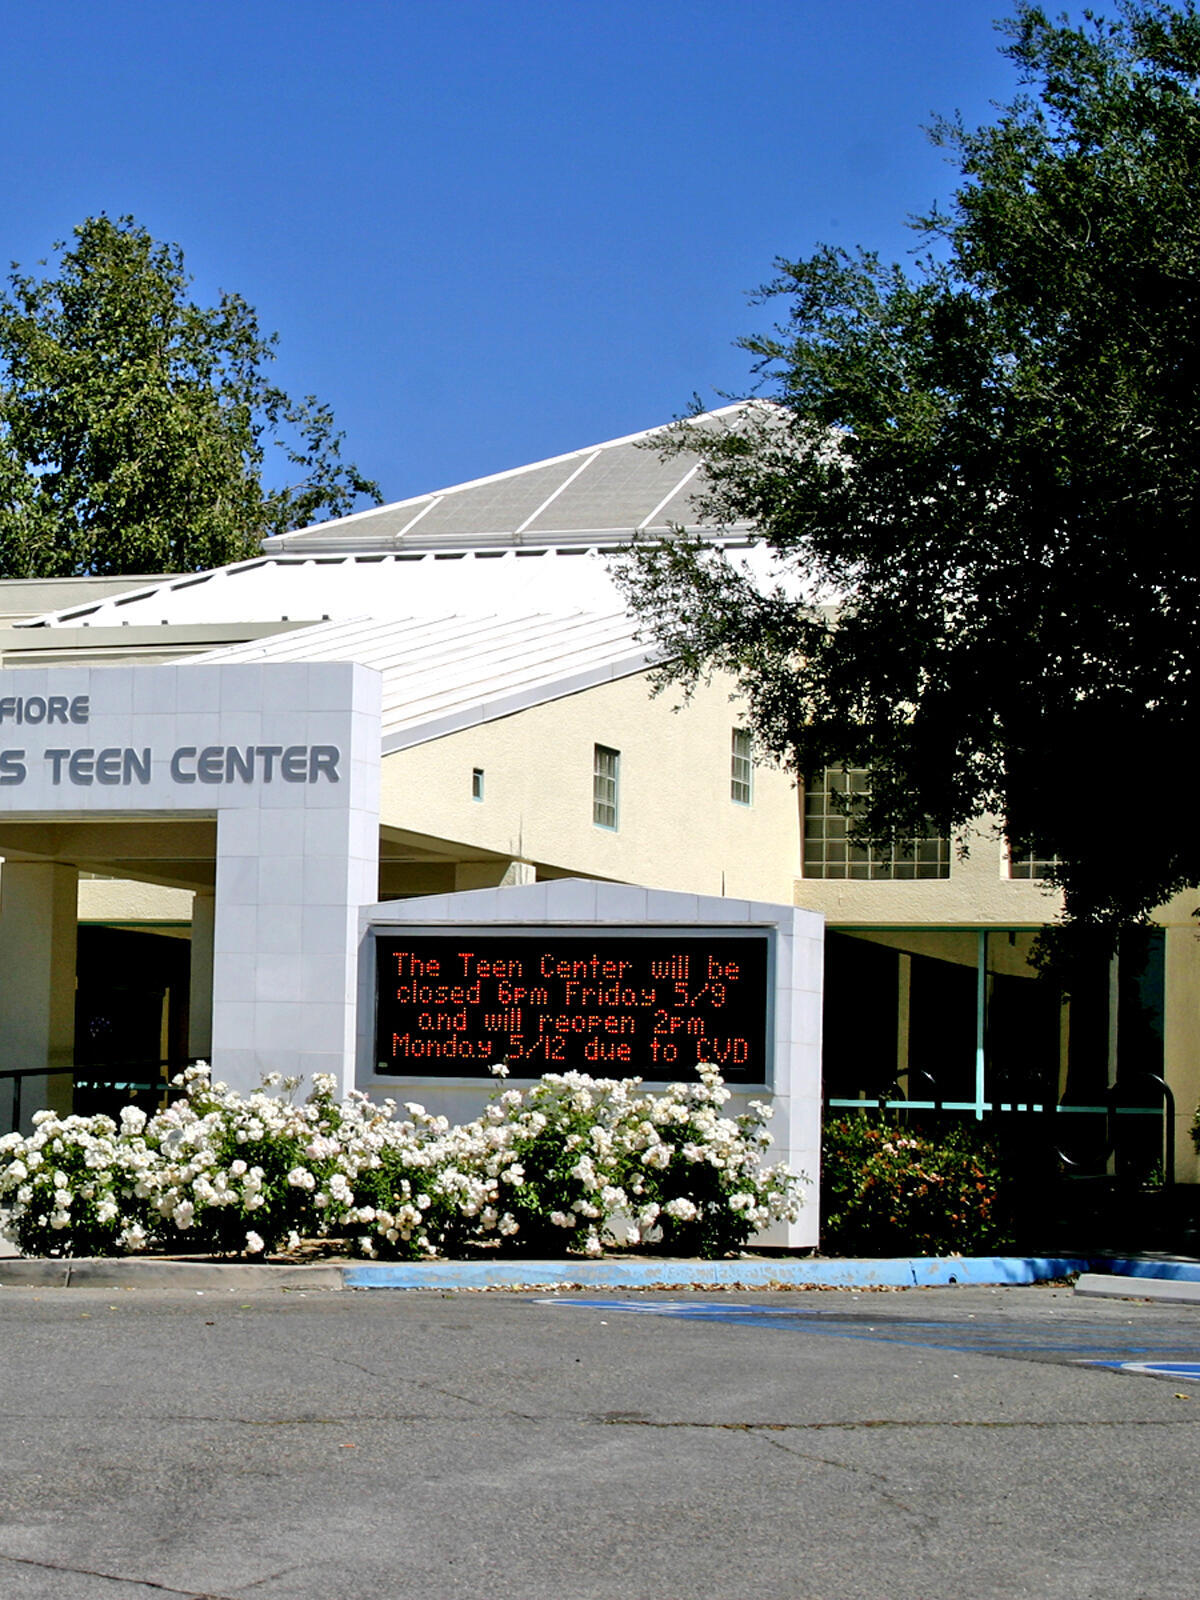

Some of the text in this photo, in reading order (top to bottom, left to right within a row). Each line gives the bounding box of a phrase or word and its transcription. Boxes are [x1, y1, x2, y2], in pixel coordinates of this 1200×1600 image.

[44, 747, 151, 786] TEEN
[170, 745, 341, 784] CENTER
[393, 952, 740, 981] The Teen Center will be
[397, 980, 726, 1008] closed 6pm Friday 5/9
[419, 1007, 705, 1035] and will reopen 2pm
[393, 1033, 749, 1064] Monday 5/12 due to CVD
